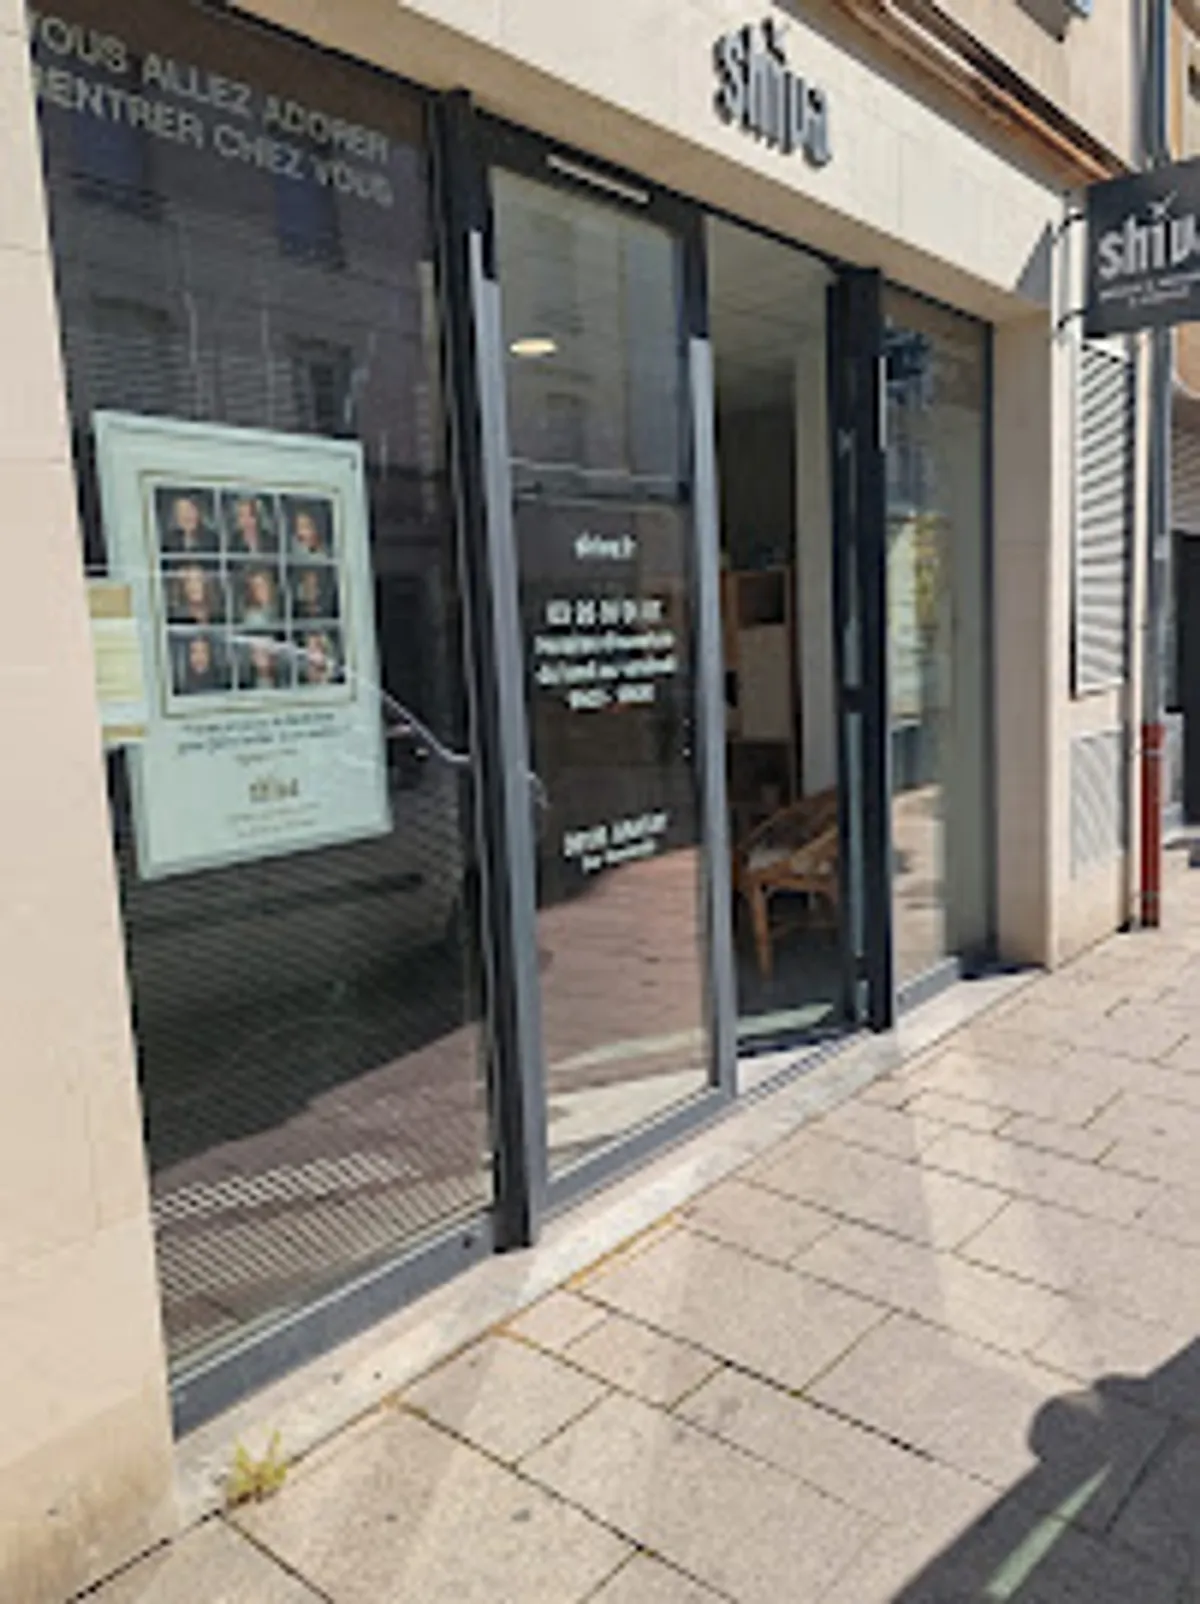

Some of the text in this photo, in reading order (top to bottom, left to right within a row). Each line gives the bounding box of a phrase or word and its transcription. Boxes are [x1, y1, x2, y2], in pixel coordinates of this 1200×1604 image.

[142, 52, 253, 118] ALLEZ
[262, 95, 390, 164] ADORER
[213, 124, 303, 179] CHEZ
[310, 155, 393, 207] VOUS
[1098, 192, 1200, 281] shiv
